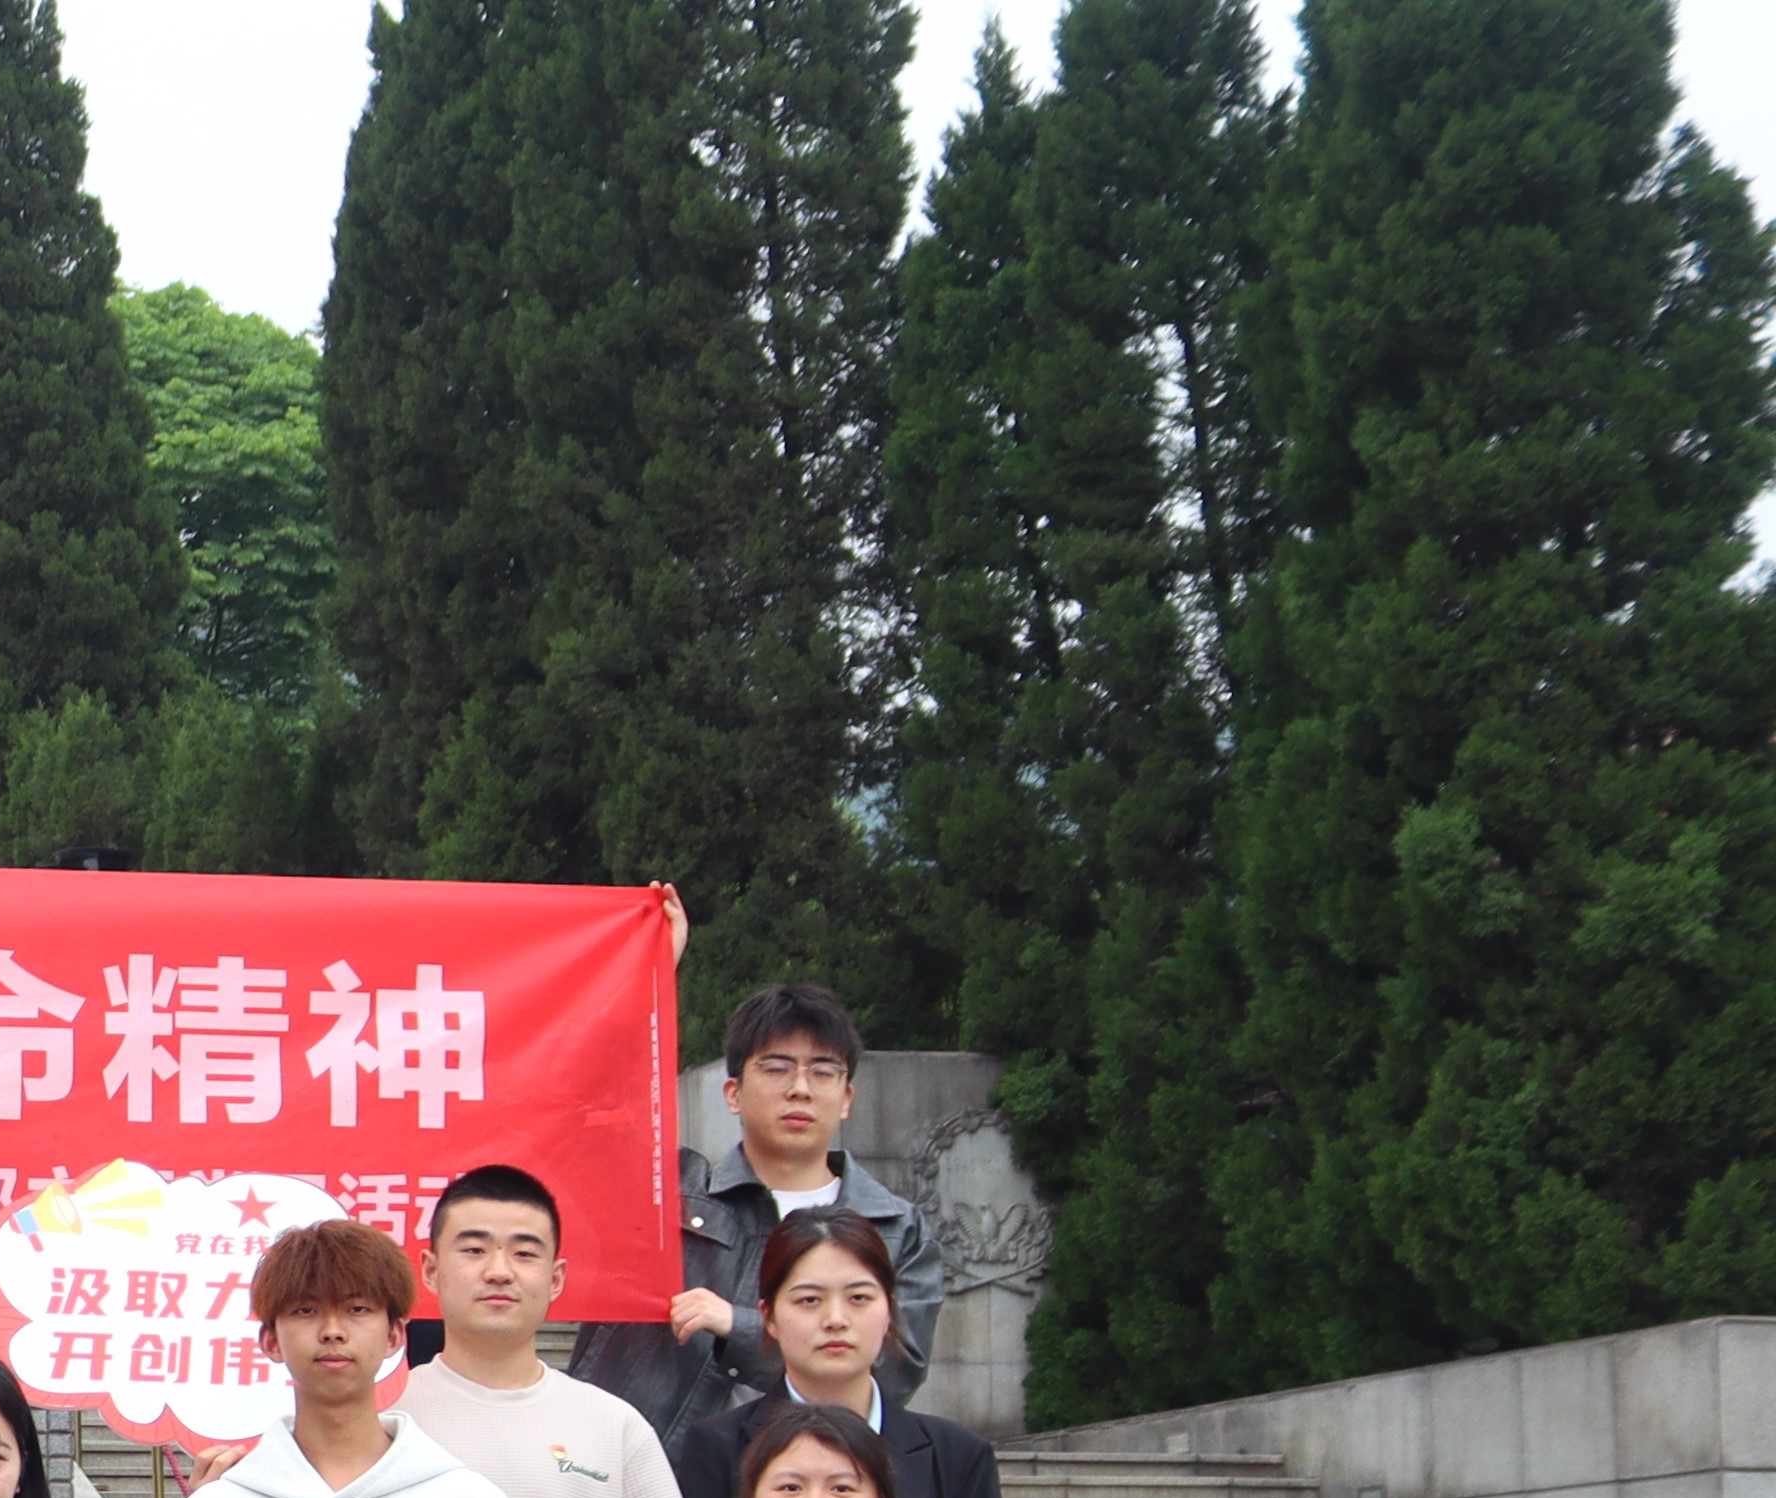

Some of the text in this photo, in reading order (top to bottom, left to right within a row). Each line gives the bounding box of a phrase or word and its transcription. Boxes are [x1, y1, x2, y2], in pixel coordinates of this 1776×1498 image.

[175, 1232, 271, 1256] 党在我
[46, 1266, 252, 1322] 汲取力
[49, 1331, 298, 1388] 开创伟
